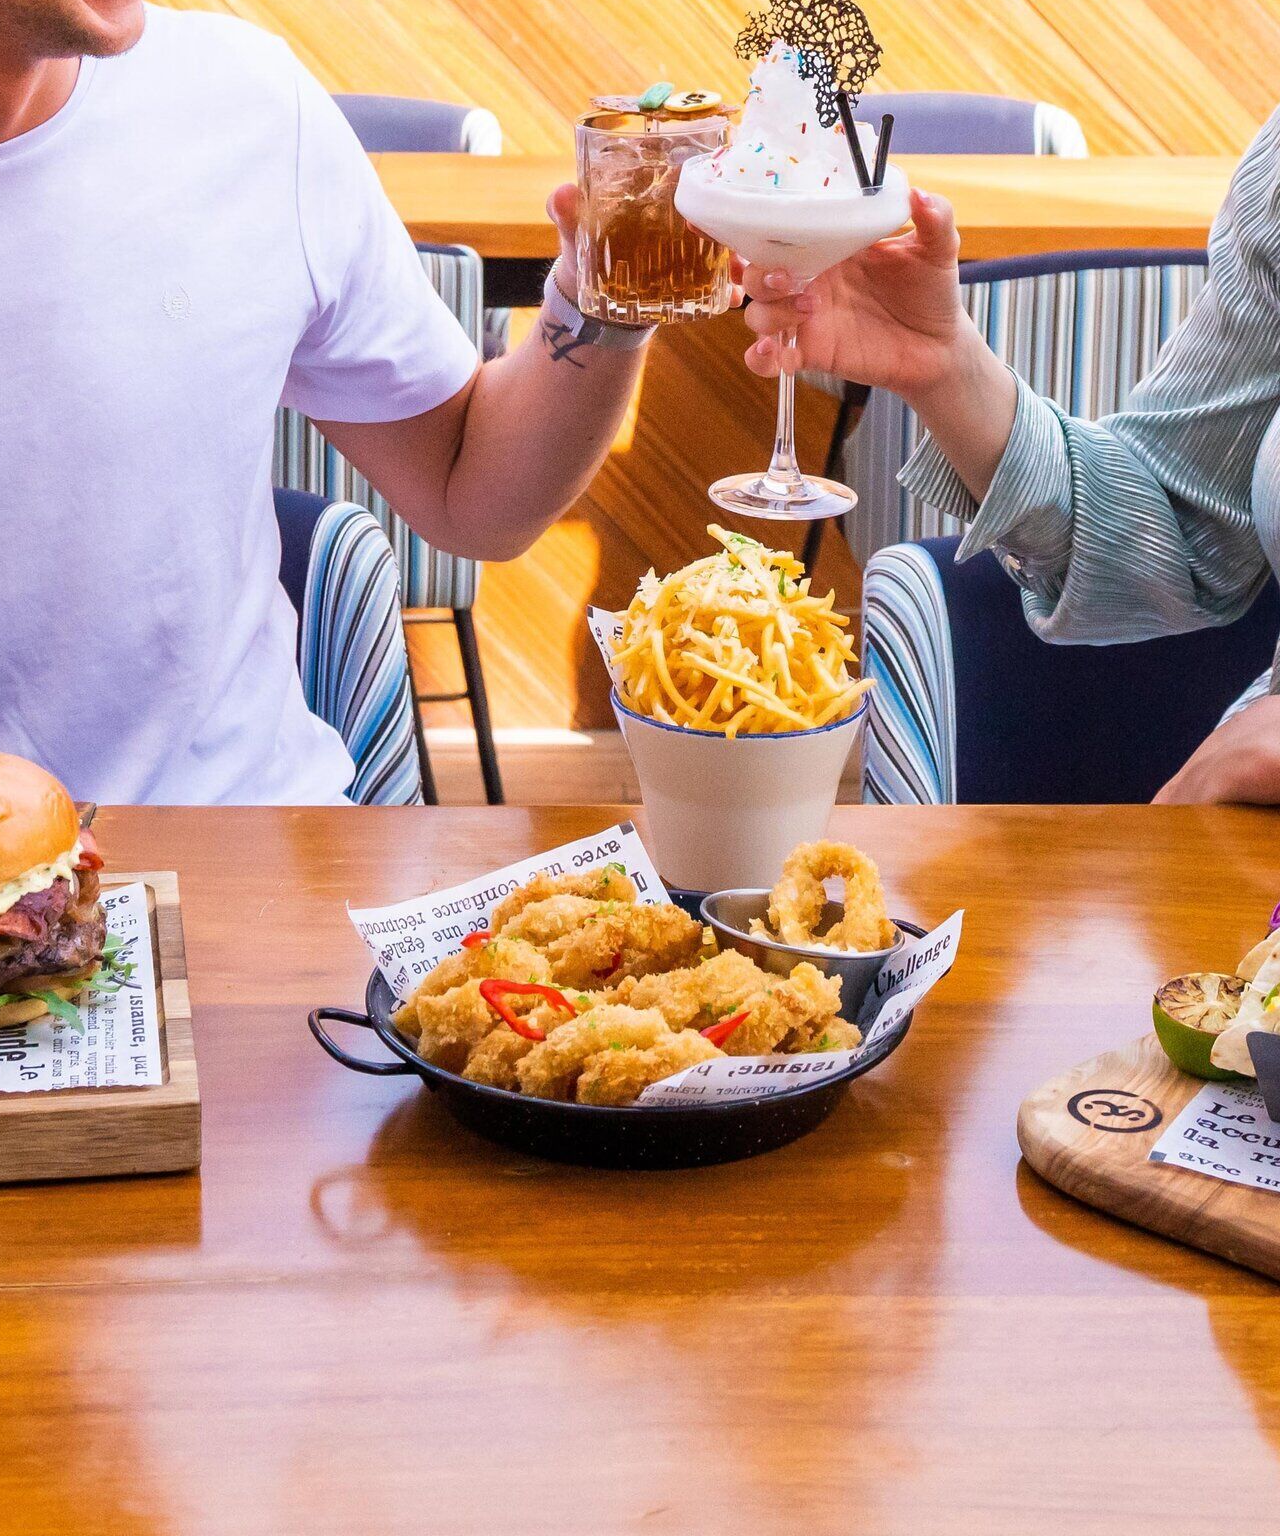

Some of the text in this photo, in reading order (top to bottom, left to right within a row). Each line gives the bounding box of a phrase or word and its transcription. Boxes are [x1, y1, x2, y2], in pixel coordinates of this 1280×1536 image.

[571, 840, 620, 870] avec
[431, 878, 519, 920] confiance
[432, 924, 464, 944] une
[874, 934, 951, 998] Challenge
[1205, 1102, 1257, 1125] Le
[1183, 1128, 1219, 1150] la
[1178, 1151, 1242, 1176] avec
